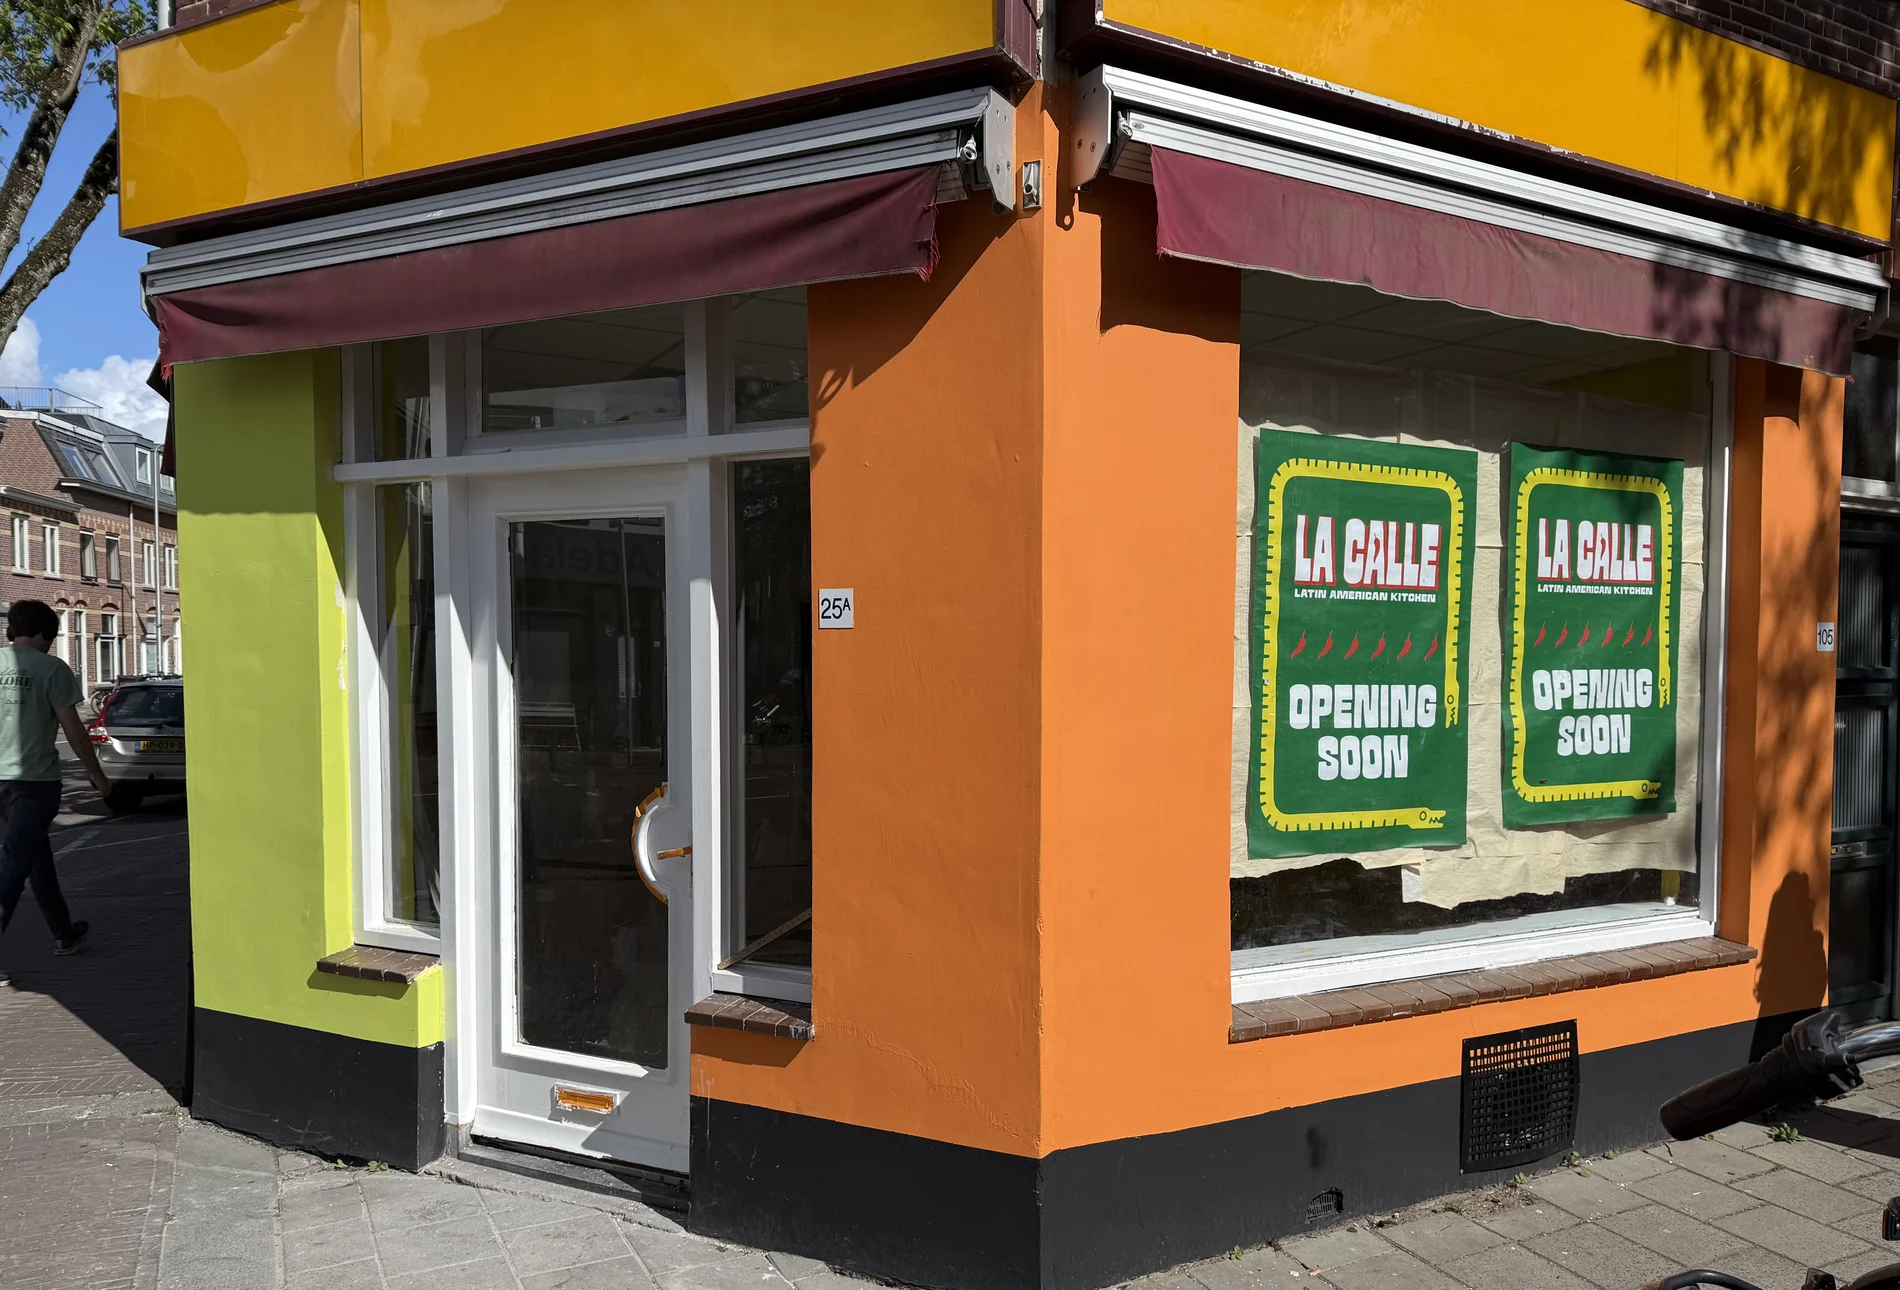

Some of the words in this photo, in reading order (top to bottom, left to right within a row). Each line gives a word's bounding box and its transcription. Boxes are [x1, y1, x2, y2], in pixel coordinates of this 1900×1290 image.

[1294, 515, 1336, 586] LA
[1343, 518, 1442, 590] CALLE
[1538, 518, 1572, 582] LA
[1577, 521, 1654, 584] CALLE
[821, 597, 851, 620] 25A
[1294, 588, 1327, 599] LATIN
[1329, 590, 1388, 601] AMERICAN
[1390, 592, 1436, 603] KITCHEN
[1537, 583, 1564, 593] LATIN
[1565, 585, 1612, 595] AMERICAN
[1613, 586, 1653, 595] KITCHEN
[1817, 629, 1834, 645] 105
[1289, 684, 1436, 729] OPENING
[1533, 668, 1653, 710] OPENING
[1557, 714, 1631, 756] SOON
[1317, 735, 1409, 781] SOON
